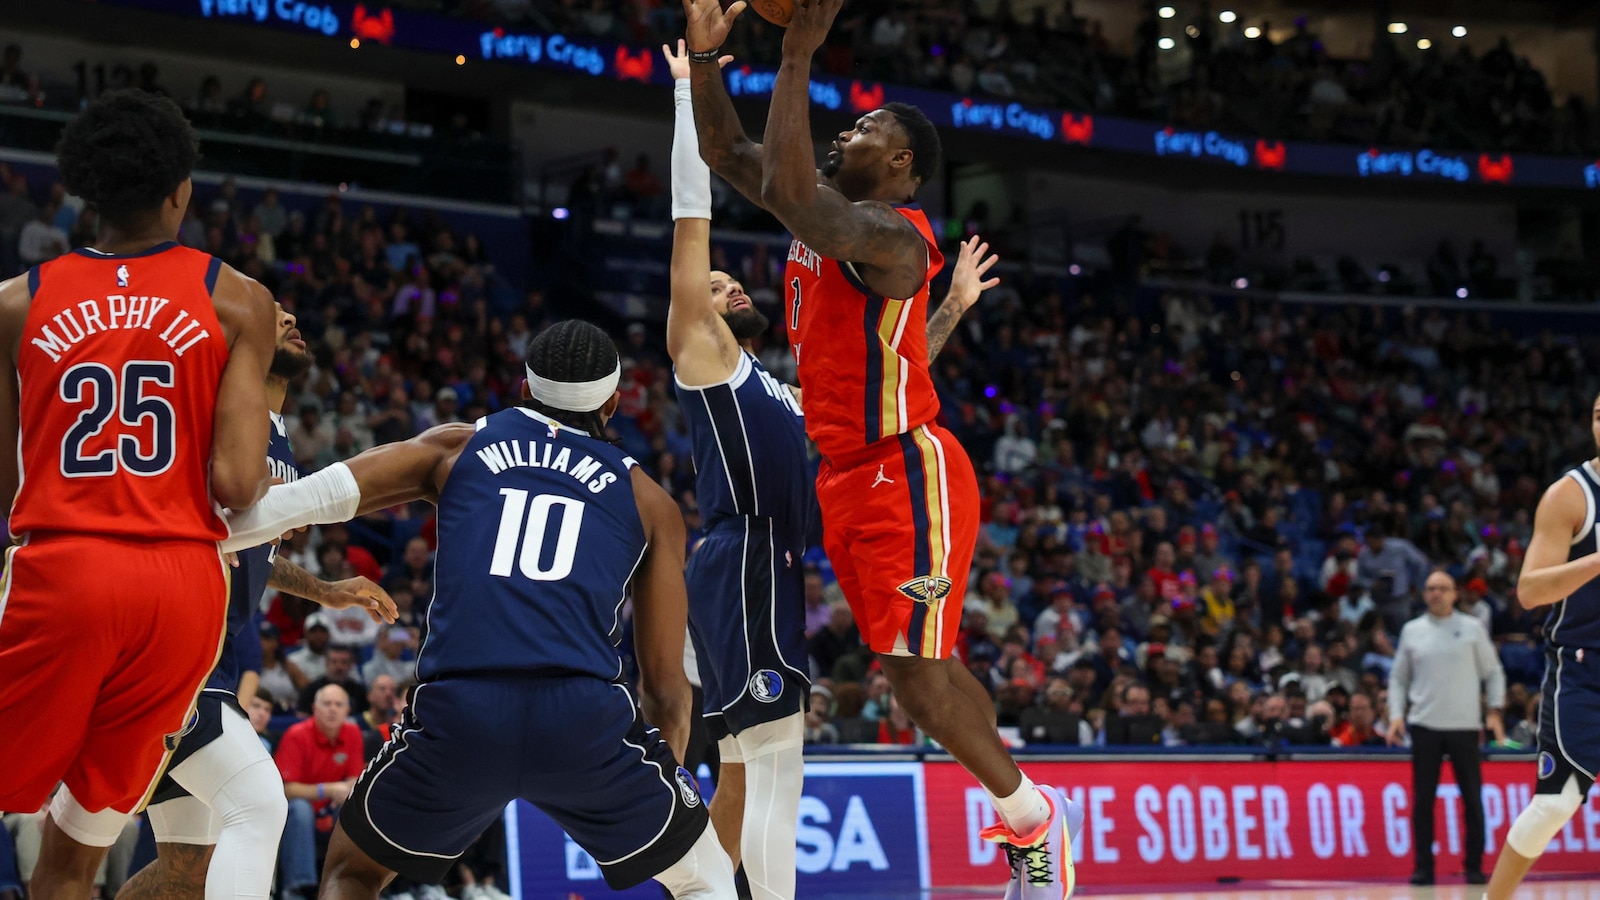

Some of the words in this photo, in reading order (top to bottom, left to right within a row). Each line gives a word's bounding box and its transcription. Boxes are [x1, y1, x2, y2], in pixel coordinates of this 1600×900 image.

[480, 28, 542, 62] Fiery
[547, 34, 604, 75] Crab
[951, 98, 1003, 129] Fiery
[1006, 102, 1054, 140] Crab
[1154, 127, 1202, 157] Fiery
[1357, 148, 1413, 177] Fiery
[30, 294, 170, 363] MURPHY
[158, 309, 210, 357] III
[791, 276, 801, 330] 1
[59, 360, 176, 478] 25
[476, 439, 618, 494] WILLIAMS
[489, 487, 586, 581] 10
[1134, 783, 1294, 864] SOBER
[1307, 782, 1369, 859] OR
[1382, 782, 1462, 857] GT
